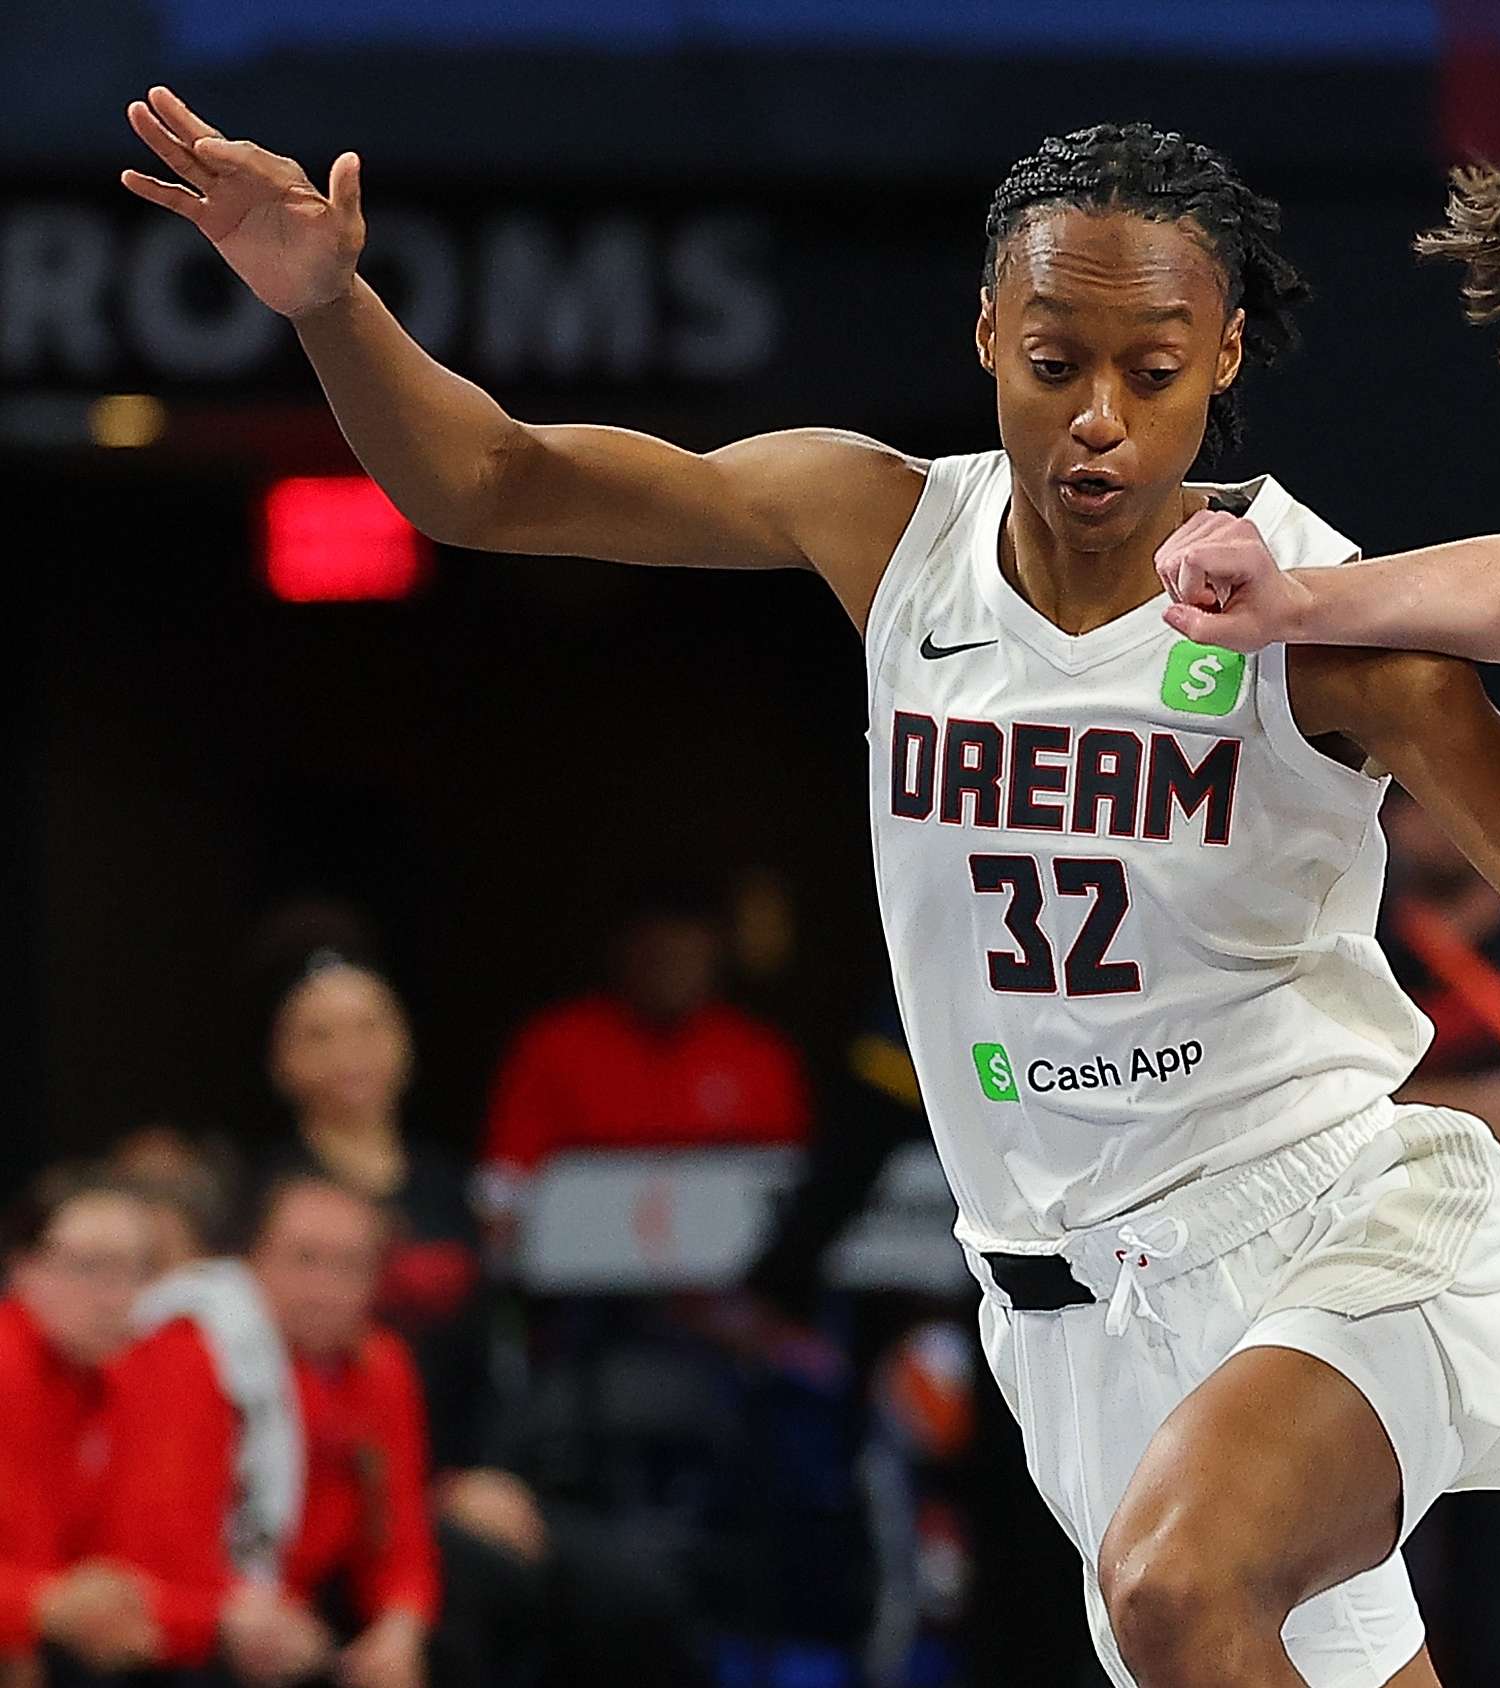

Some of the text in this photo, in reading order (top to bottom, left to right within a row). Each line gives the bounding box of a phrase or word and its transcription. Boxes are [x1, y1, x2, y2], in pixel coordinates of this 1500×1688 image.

[891, 709, 1242, 847] DREAM
[967, 853, 1142, 998] 32
[1027, 1055, 1122, 1092] Cash
[1130, 1039, 1203, 1083] App
